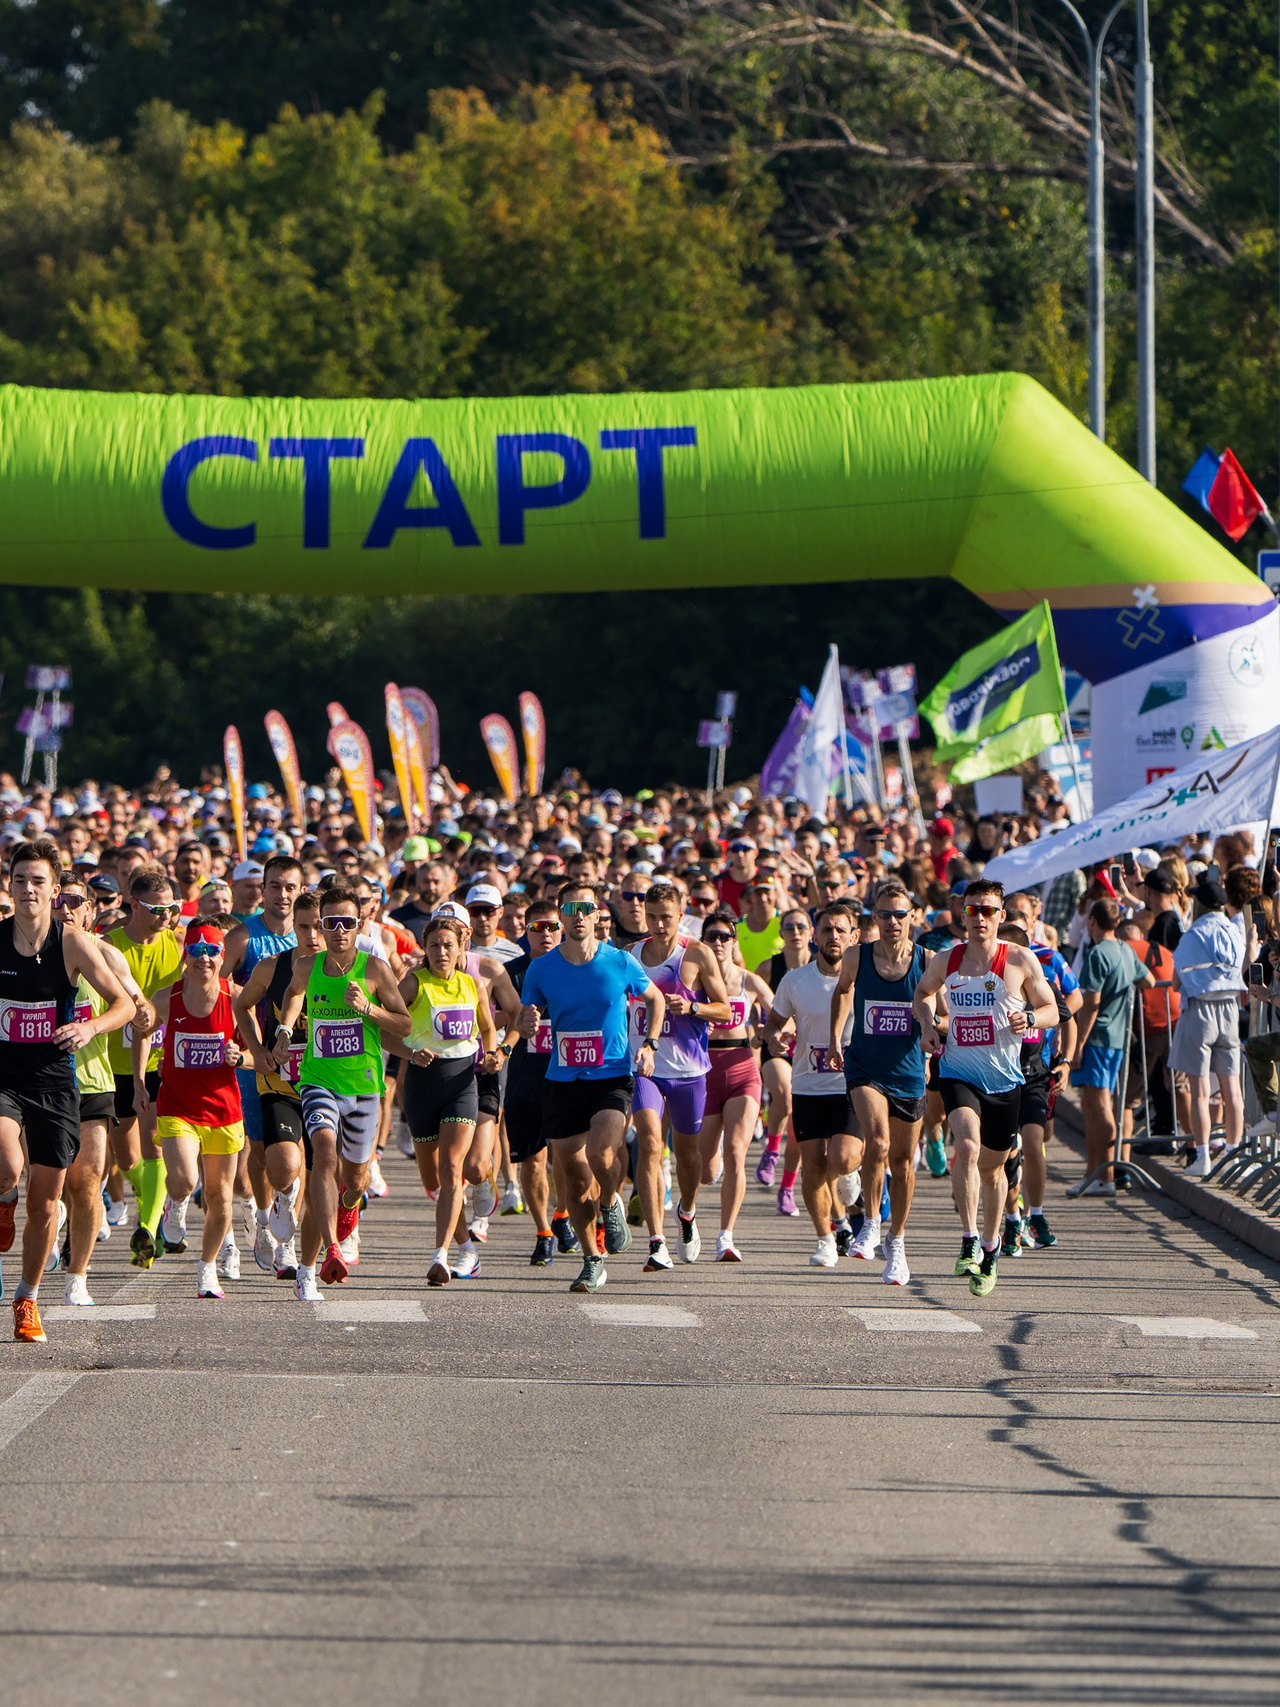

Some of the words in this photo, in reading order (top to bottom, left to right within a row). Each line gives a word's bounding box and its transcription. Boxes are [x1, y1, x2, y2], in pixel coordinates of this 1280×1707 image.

[160, 426, 697, 550] СТАРТ
[950, 991, 996, 1007] RUSSIA
[22, 1012, 47, 1020] КИРИЛЛ
[882, 1009, 905, 1017] НИКОЛАЙ
[19, 1020, 52, 1038] 1818
[448, 1020, 473, 1036] 5217
[879, 1017, 908, 1032] 2575
[960, 1019, 990, 1028] ВЛАДИСЛАВ
[330, 1027, 355, 1037] АЛЕКСЕЙ
[961, 1027, 990, 1043] 3395
[190, 1042, 221, 1050] АЛЕКСАНДР
[329, 1036, 360, 1054] 1283
[190, 1050, 221, 1065] 2734
[574, 1047, 597, 1063] 370
